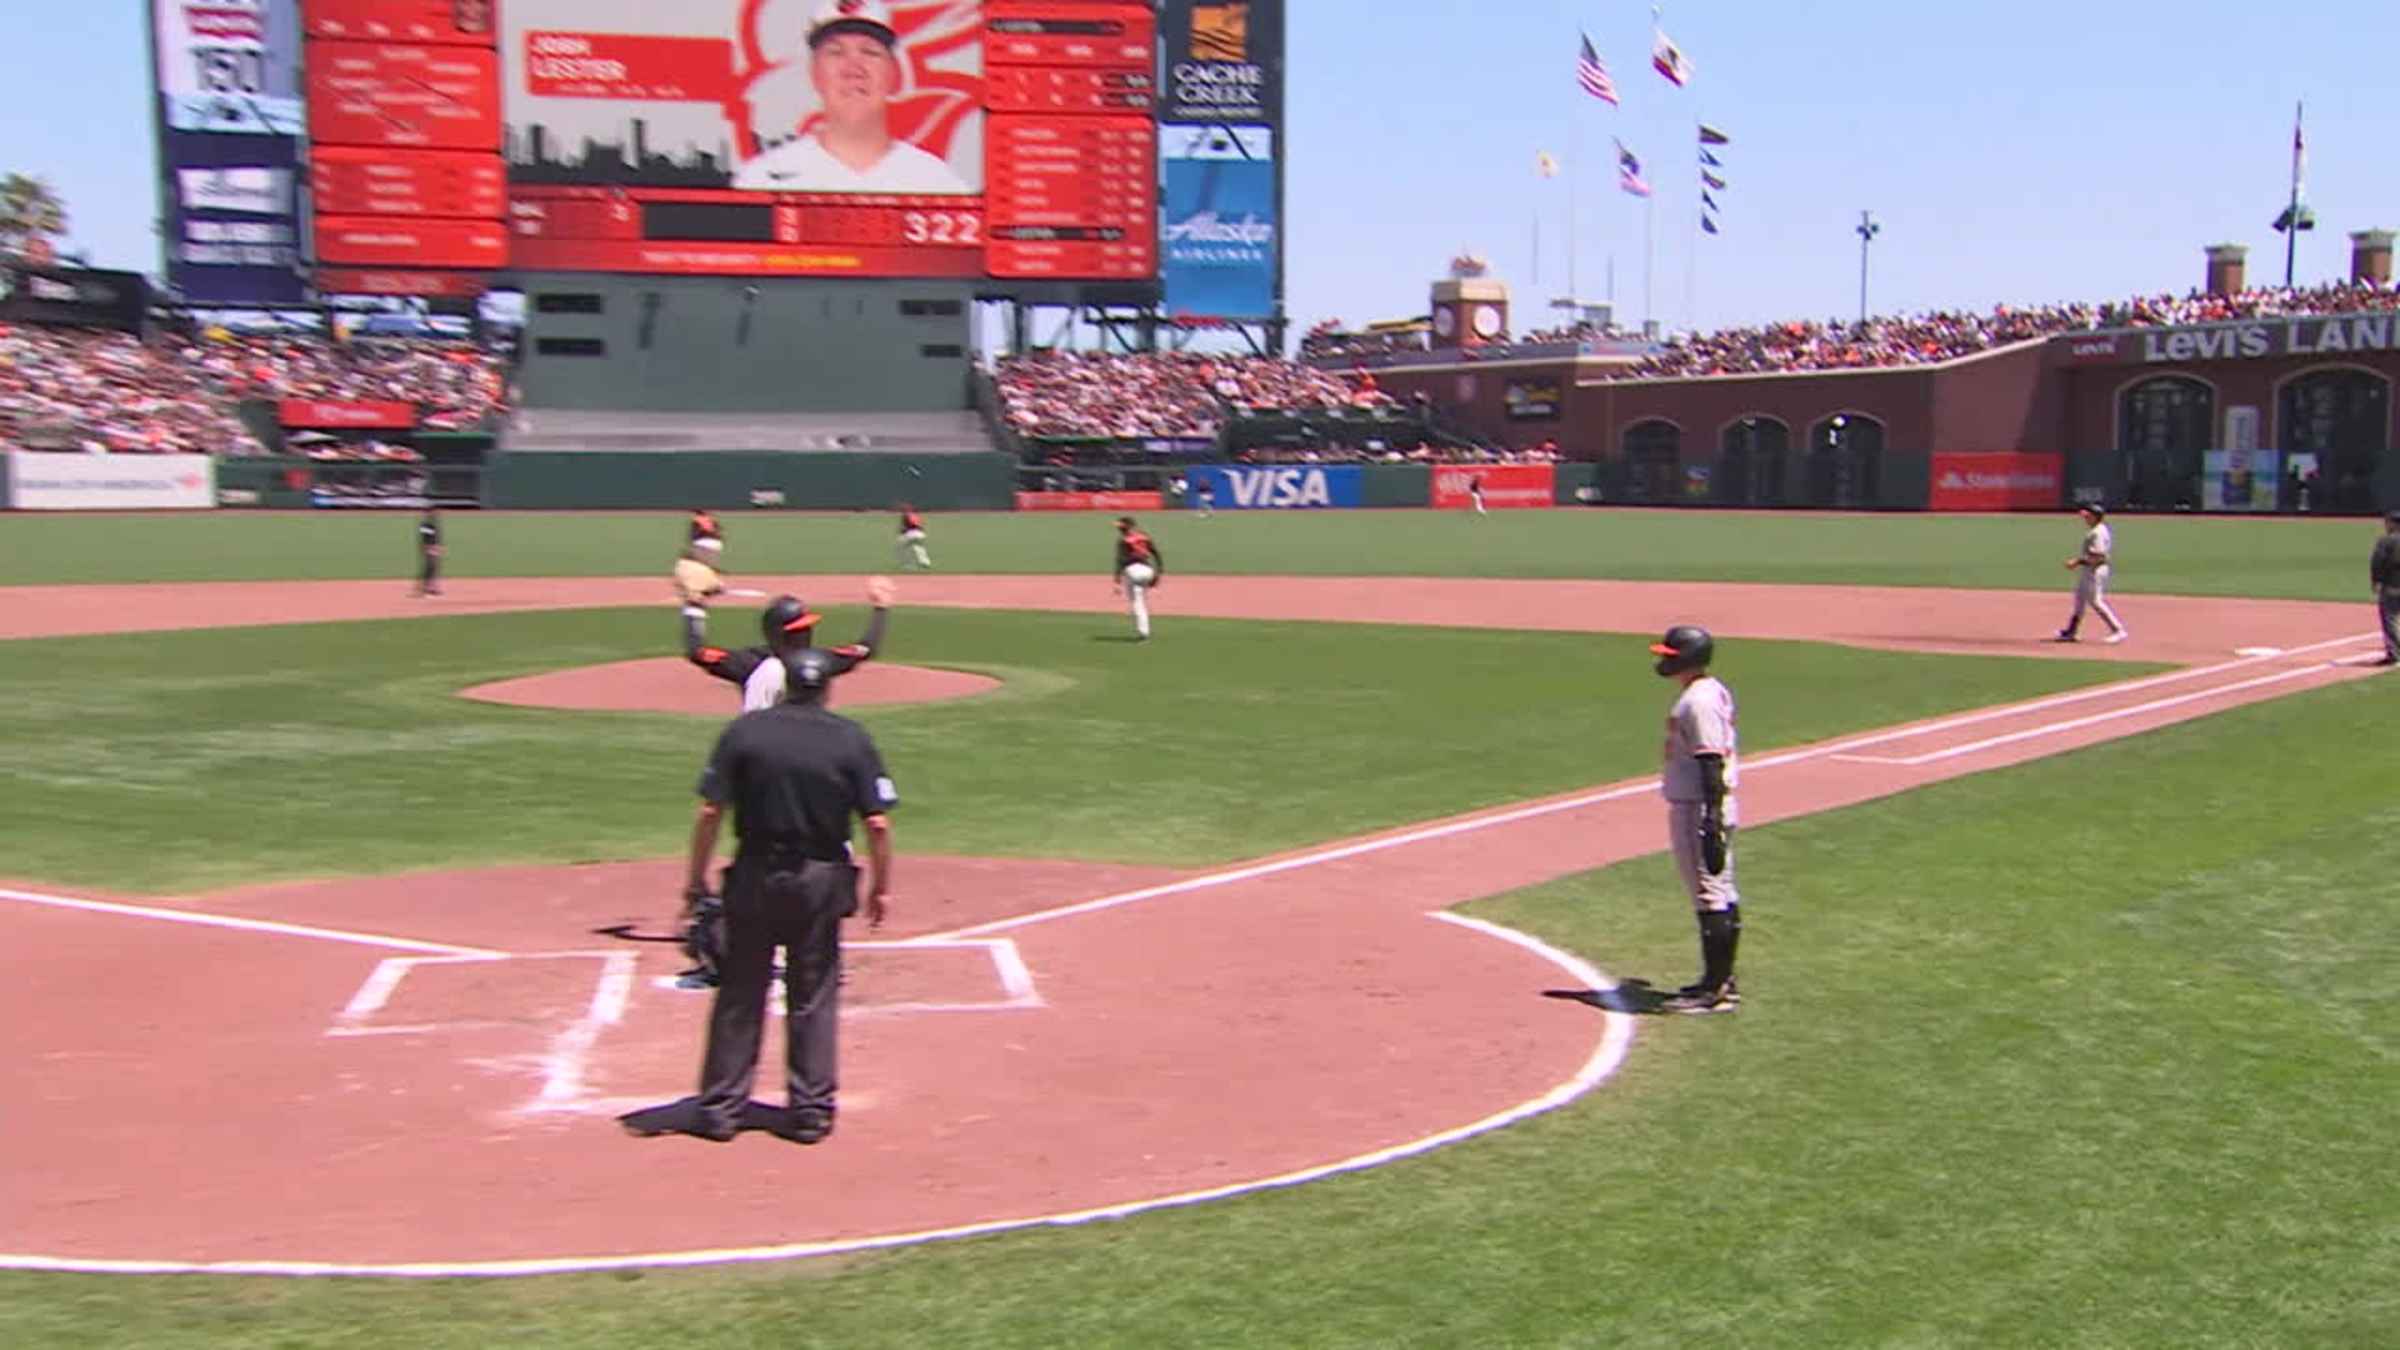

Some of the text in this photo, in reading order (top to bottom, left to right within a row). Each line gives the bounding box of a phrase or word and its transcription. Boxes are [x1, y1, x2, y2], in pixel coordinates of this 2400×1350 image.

[1174, 63, 1262, 84] CACHE
[1176, 83, 1260, 104] CREEK
[903, 210, 982, 243] 322
[2287, 313, 2400, 352] LAN
[1221, 468, 1331, 506] VISA
